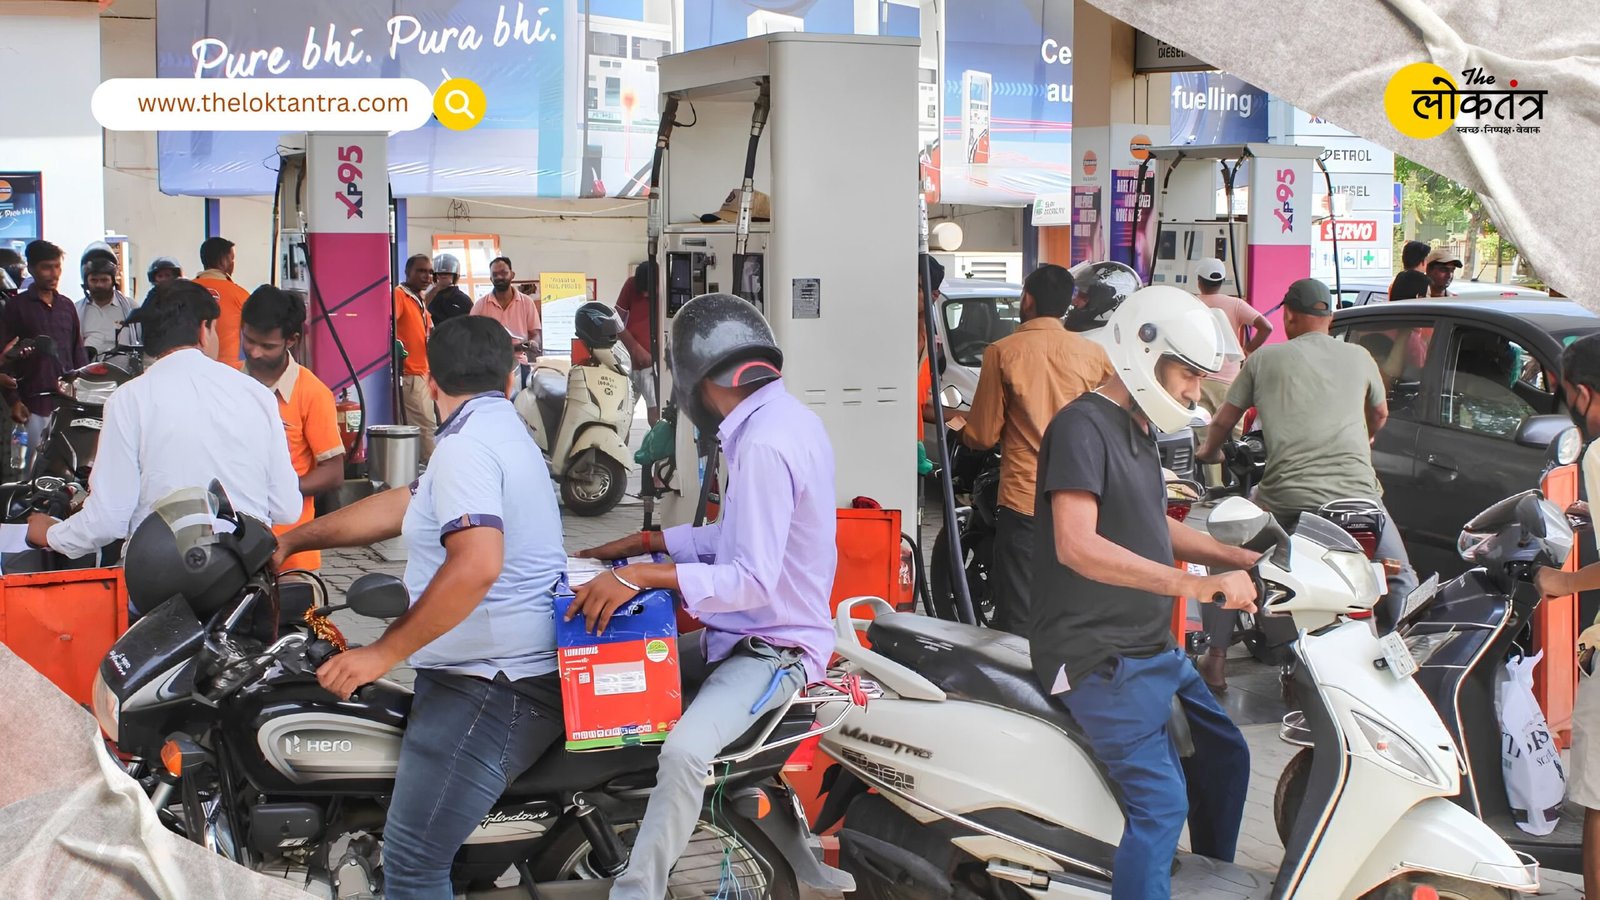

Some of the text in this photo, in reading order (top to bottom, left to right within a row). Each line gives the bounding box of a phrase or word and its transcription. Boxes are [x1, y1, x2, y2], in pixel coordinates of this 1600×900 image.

[192, 1, 557, 79] Pure bhi. Pura bhi.
[1041, 39, 1072, 64] Ce
[1172, 86, 1252, 118] fuelling
[1325, 149, 1372, 161] PETROL
[335, 145, 363, 219] XP95
[1273, 168, 1295, 233] XP95
[1324, 222, 1373, 240] SERVO
